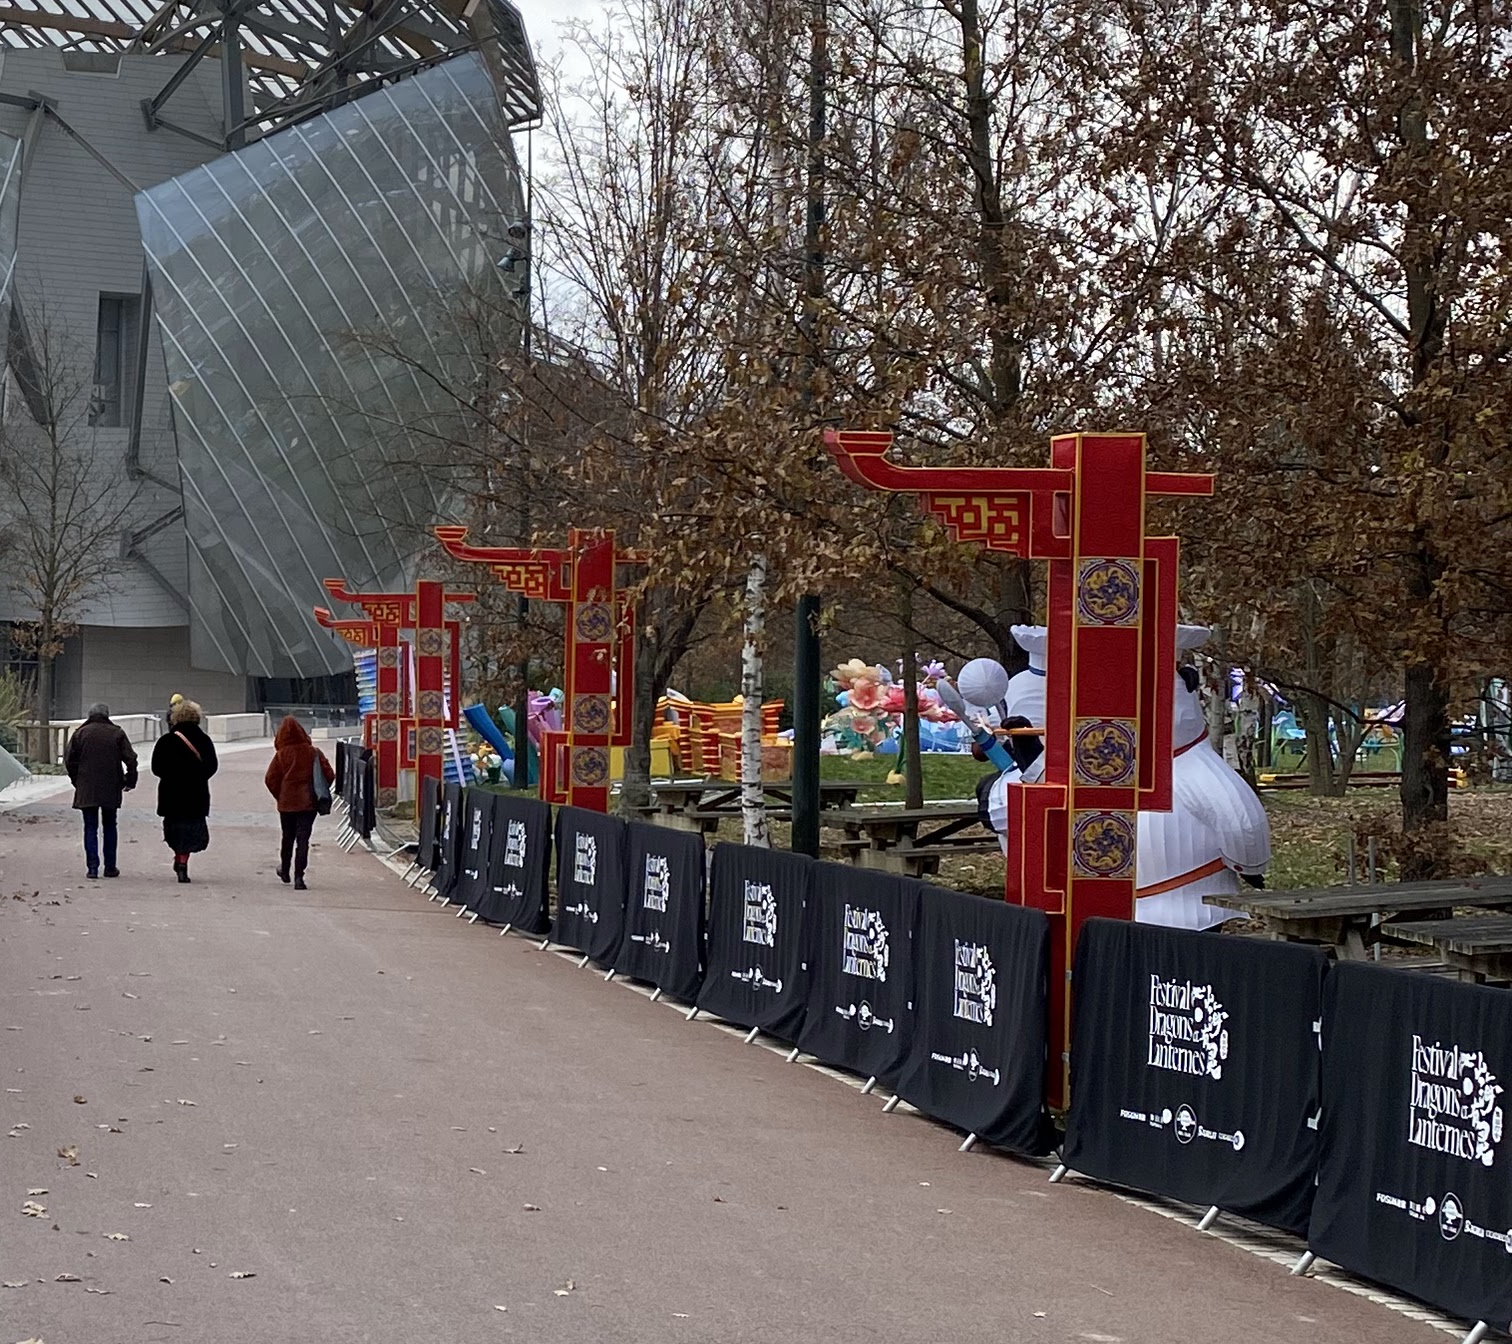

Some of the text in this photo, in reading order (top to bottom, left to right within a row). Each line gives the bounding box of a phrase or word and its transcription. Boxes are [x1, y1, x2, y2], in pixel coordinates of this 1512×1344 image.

[1150, 973, 1191, 1011] Festival
[1147, 1034, 1206, 1077] Lanternes
[1411, 1034, 1459, 1081] Festival
[1409, 1070, 1462, 1120] Dragons
[1407, 1105, 1476, 1161] Lanternes
